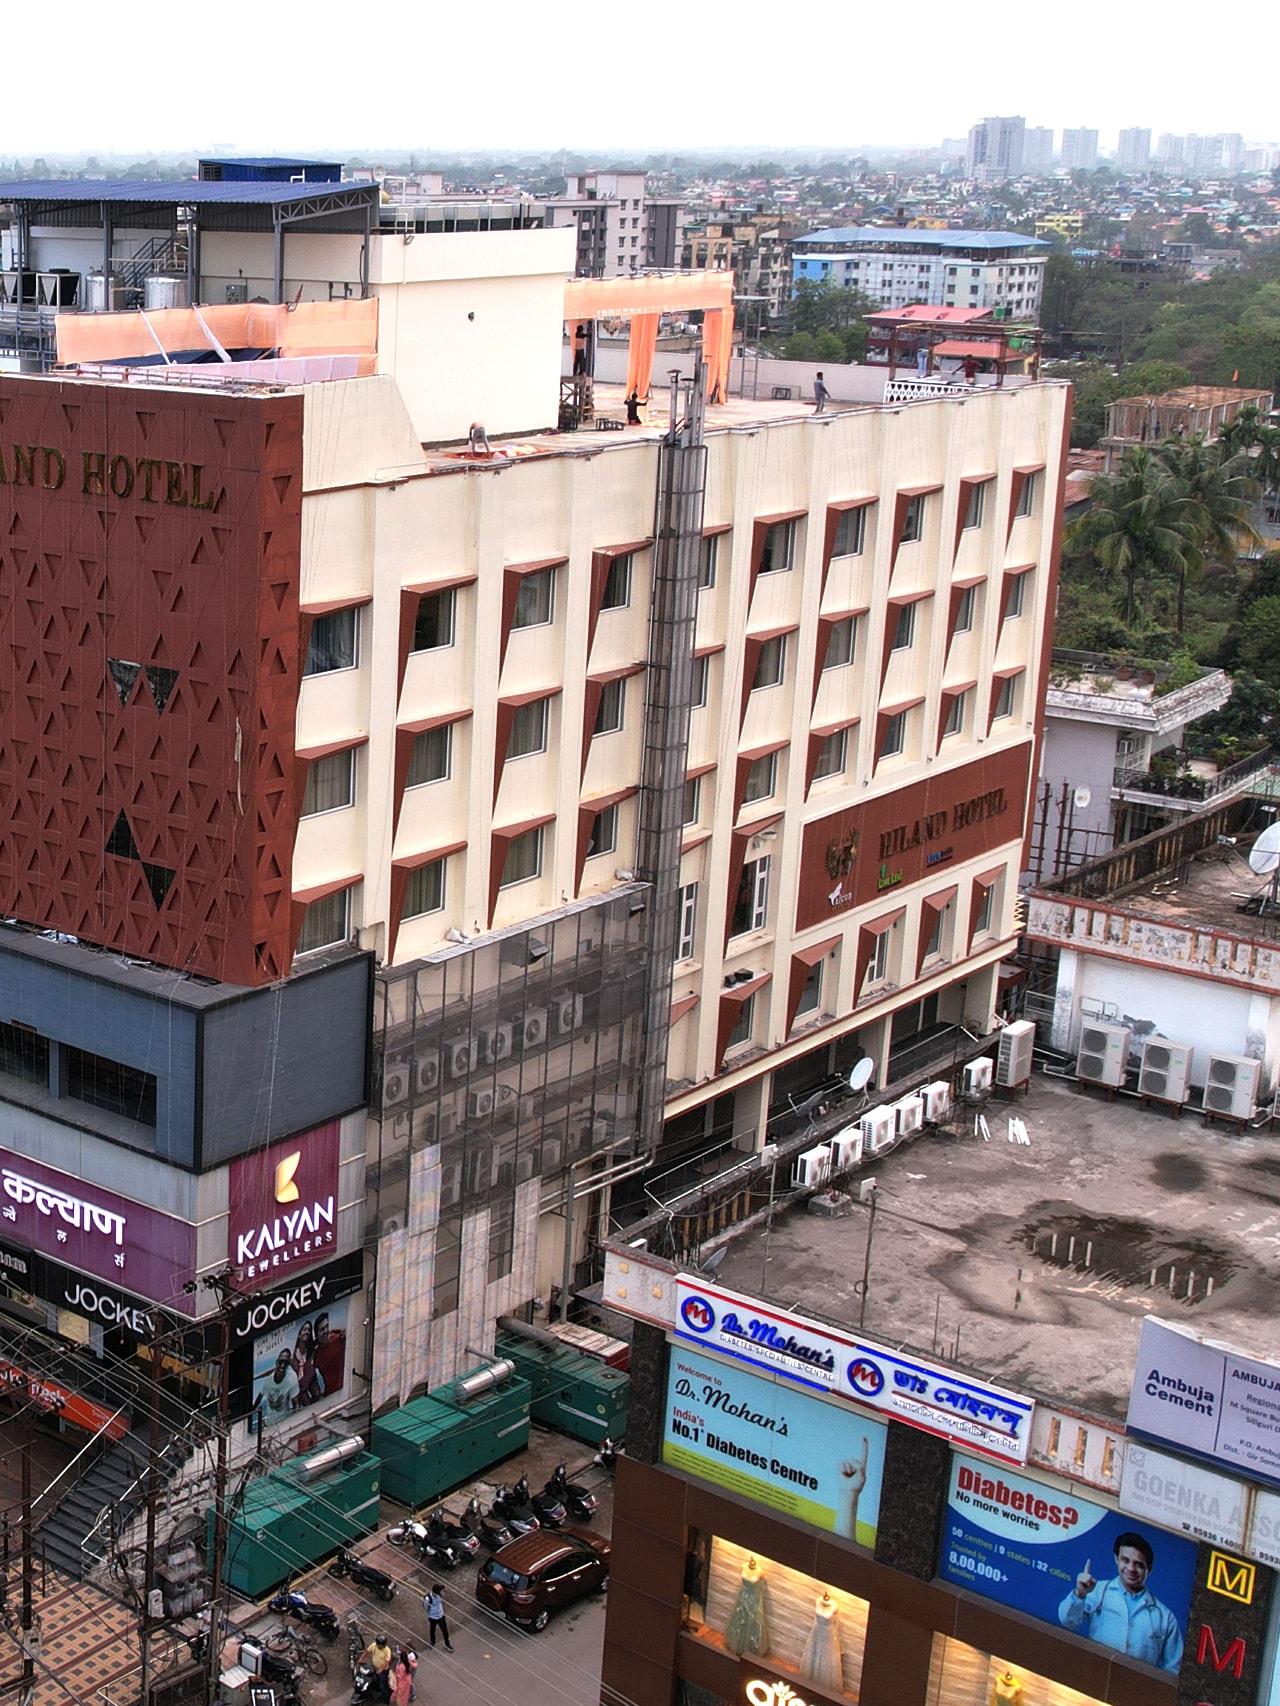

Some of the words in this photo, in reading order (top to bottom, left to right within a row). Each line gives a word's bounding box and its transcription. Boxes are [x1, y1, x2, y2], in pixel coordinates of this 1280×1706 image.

[81, 451, 215, 510] HOTEL
[878, 810, 949, 861] HILAND
[952, 787, 1008, 832] HOTEL
[1, 1168, 127, 1246] कल्याण
[238, 1196, 334, 1264] KALYAN
[237, 1231, 333, 1282] JEWELLERS
[236, 1276, 326, 1336] JOCKEY
[721, 1313, 748, 1336] Dr.
[749, 1319, 835, 1369] Mohan's
[677, 1362, 712, 1382] Welcome
[715, 1376, 723, 1386] to
[1147, 1369, 1215, 1403] Ambuja
[1232, 1369, 1280, 1392] AMBUJA
[673, 1405, 705, 1427] India's
[675, 1379, 700, 1402] Dr.
[703, 1385, 789, 1436] Mohan's
[1144, 1383, 1214, 1417] Cement
[1240, 1404, 1267, 1418] Square
[706, 1433, 768, 1470] Diabetes
[770, 1459, 819, 1490] Centre
[956, 1490, 970, 1503] No
[972, 1499, 999, 1515] more
[1002, 1510, 1040, 1531] worries
[958, 1466, 1078, 1529] Diabetes?
[1134, 1470, 1221, 1519] GOENKA
[951, 1541, 977, 1557] Trusted
[977, 1551, 987, 1563] by
[964, 1533, 993, 1550] centres
[1007, 1550, 1031, 1566] states
[1193, 1527, 1217, 1541] 95936
[1214, 1559, 1248, 1596] M
[1197, 1624, 1247, 1680] M
